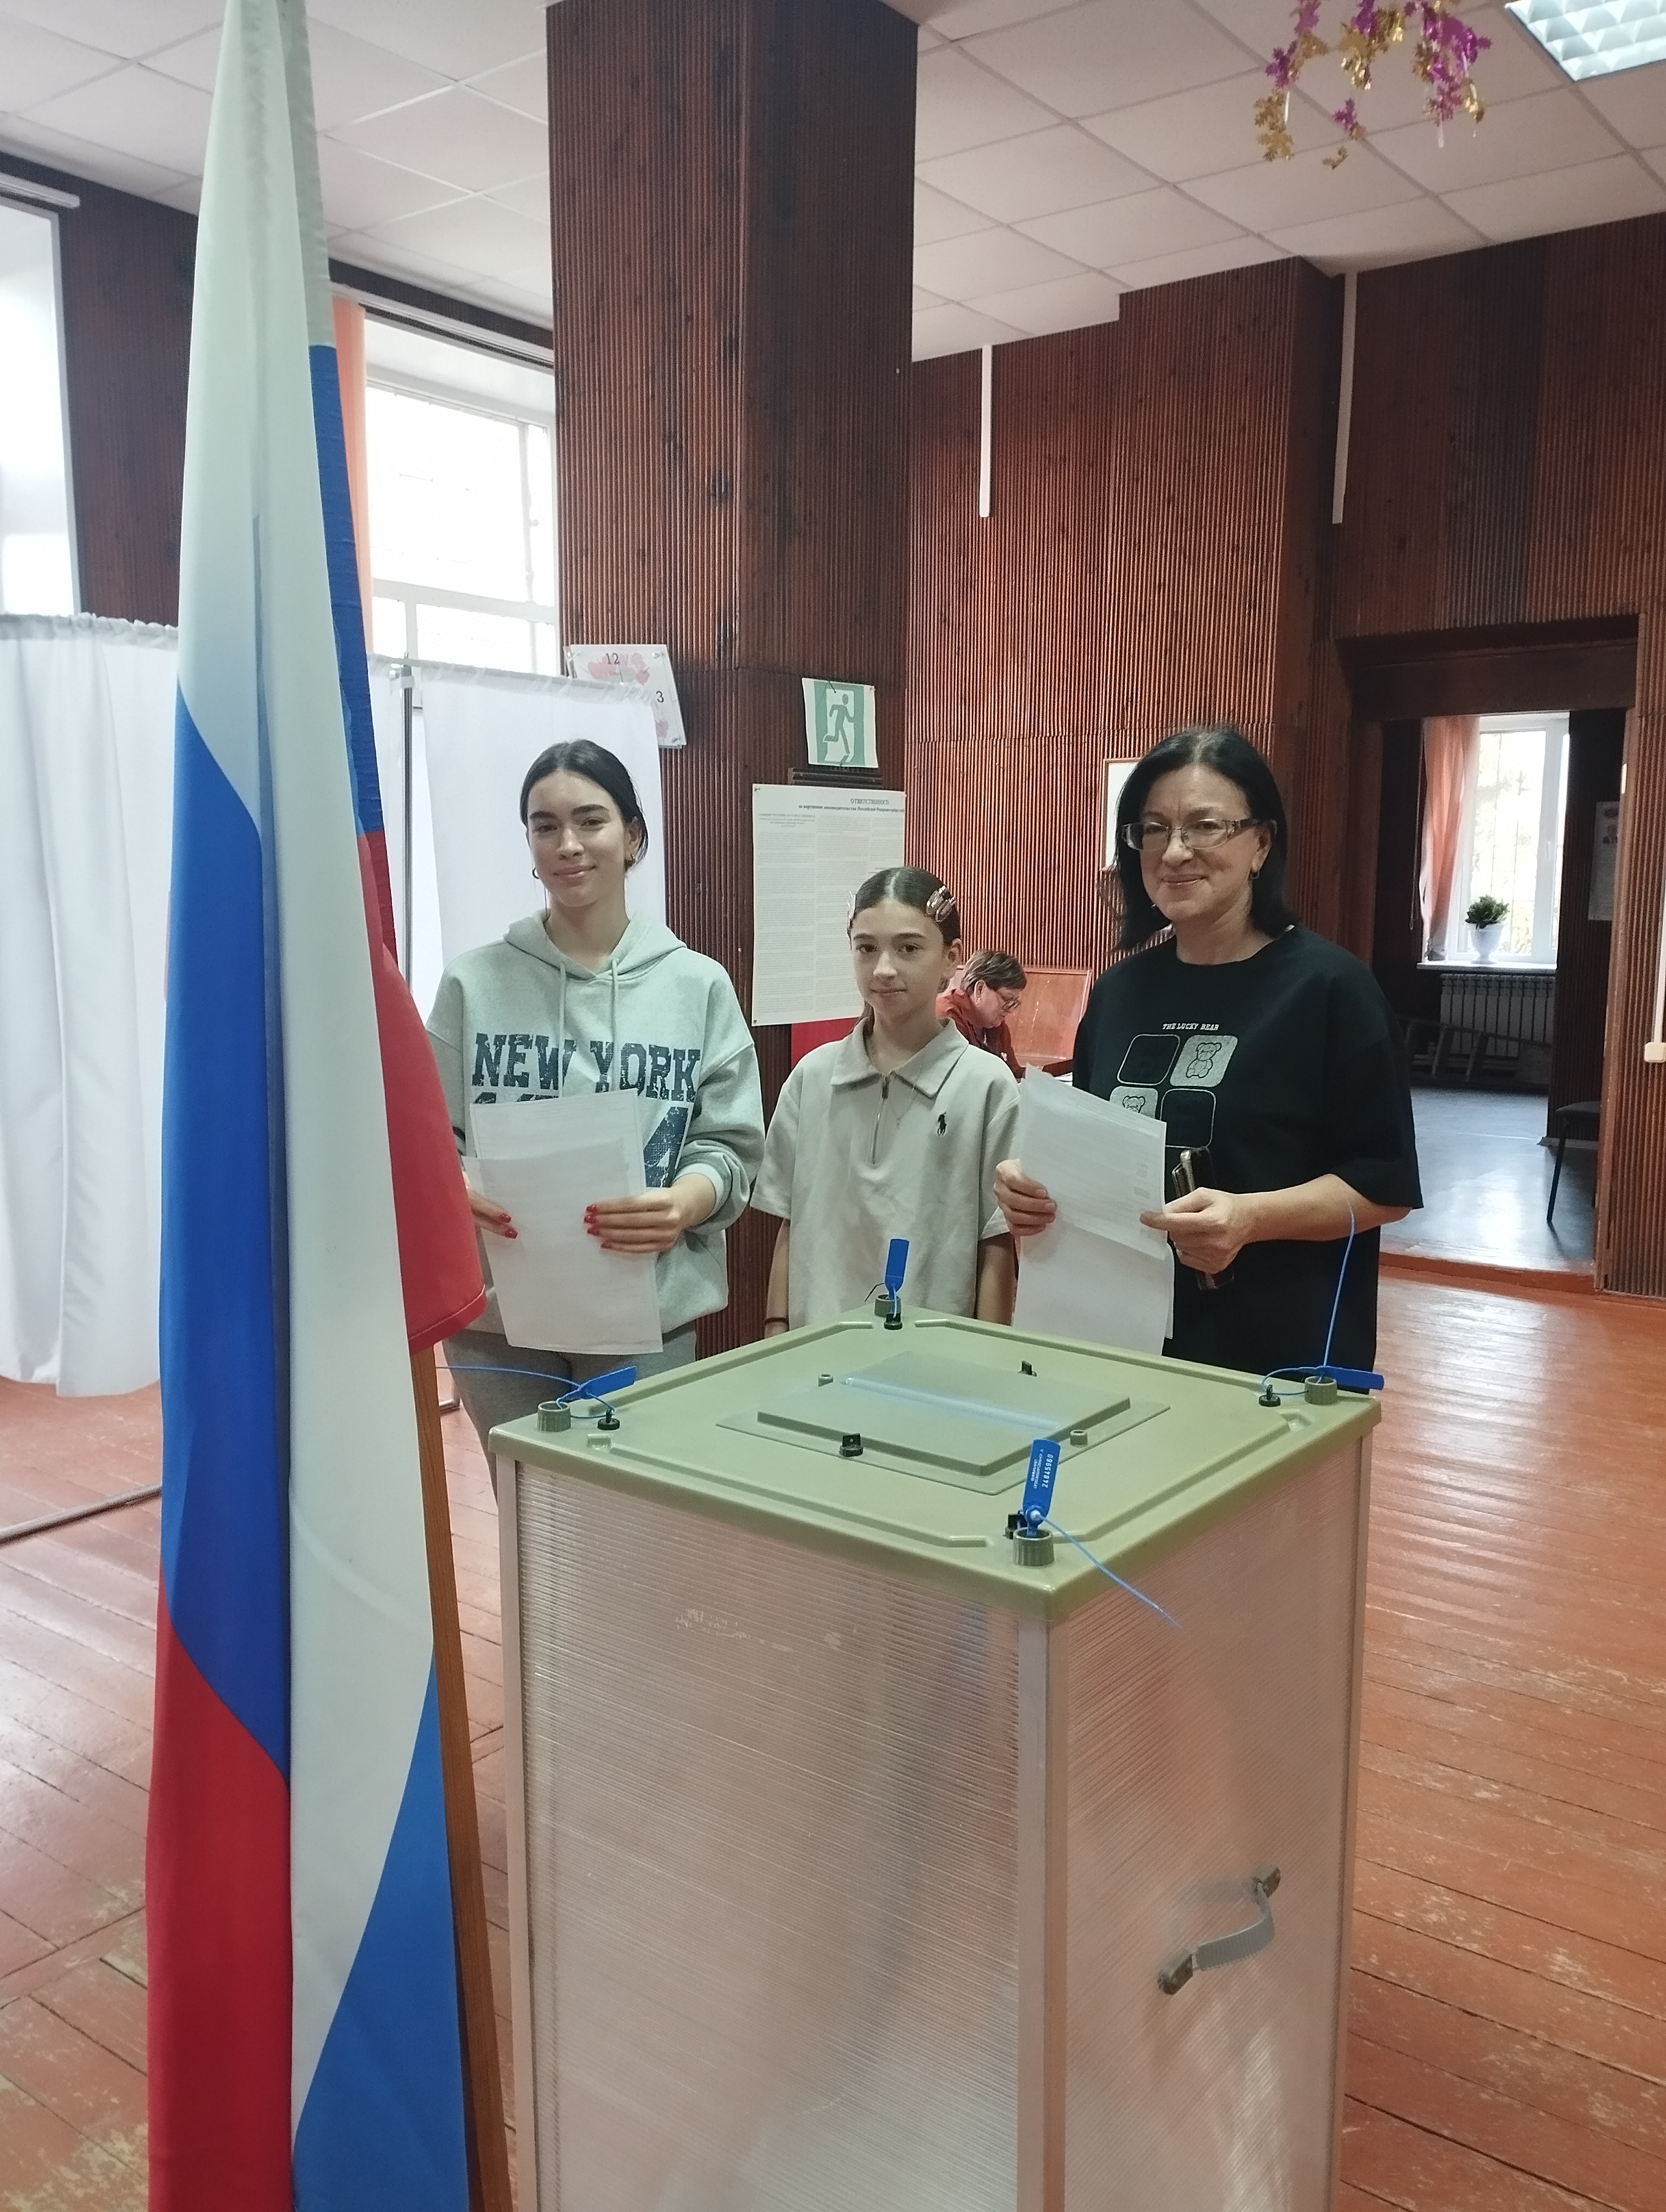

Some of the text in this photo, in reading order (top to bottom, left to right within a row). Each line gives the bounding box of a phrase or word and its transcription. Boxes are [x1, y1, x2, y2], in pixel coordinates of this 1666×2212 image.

[606, 653, 619, 665] 12
[656, 690, 664, 703] 3
[472, 1033, 701, 1103] NEW YORK
